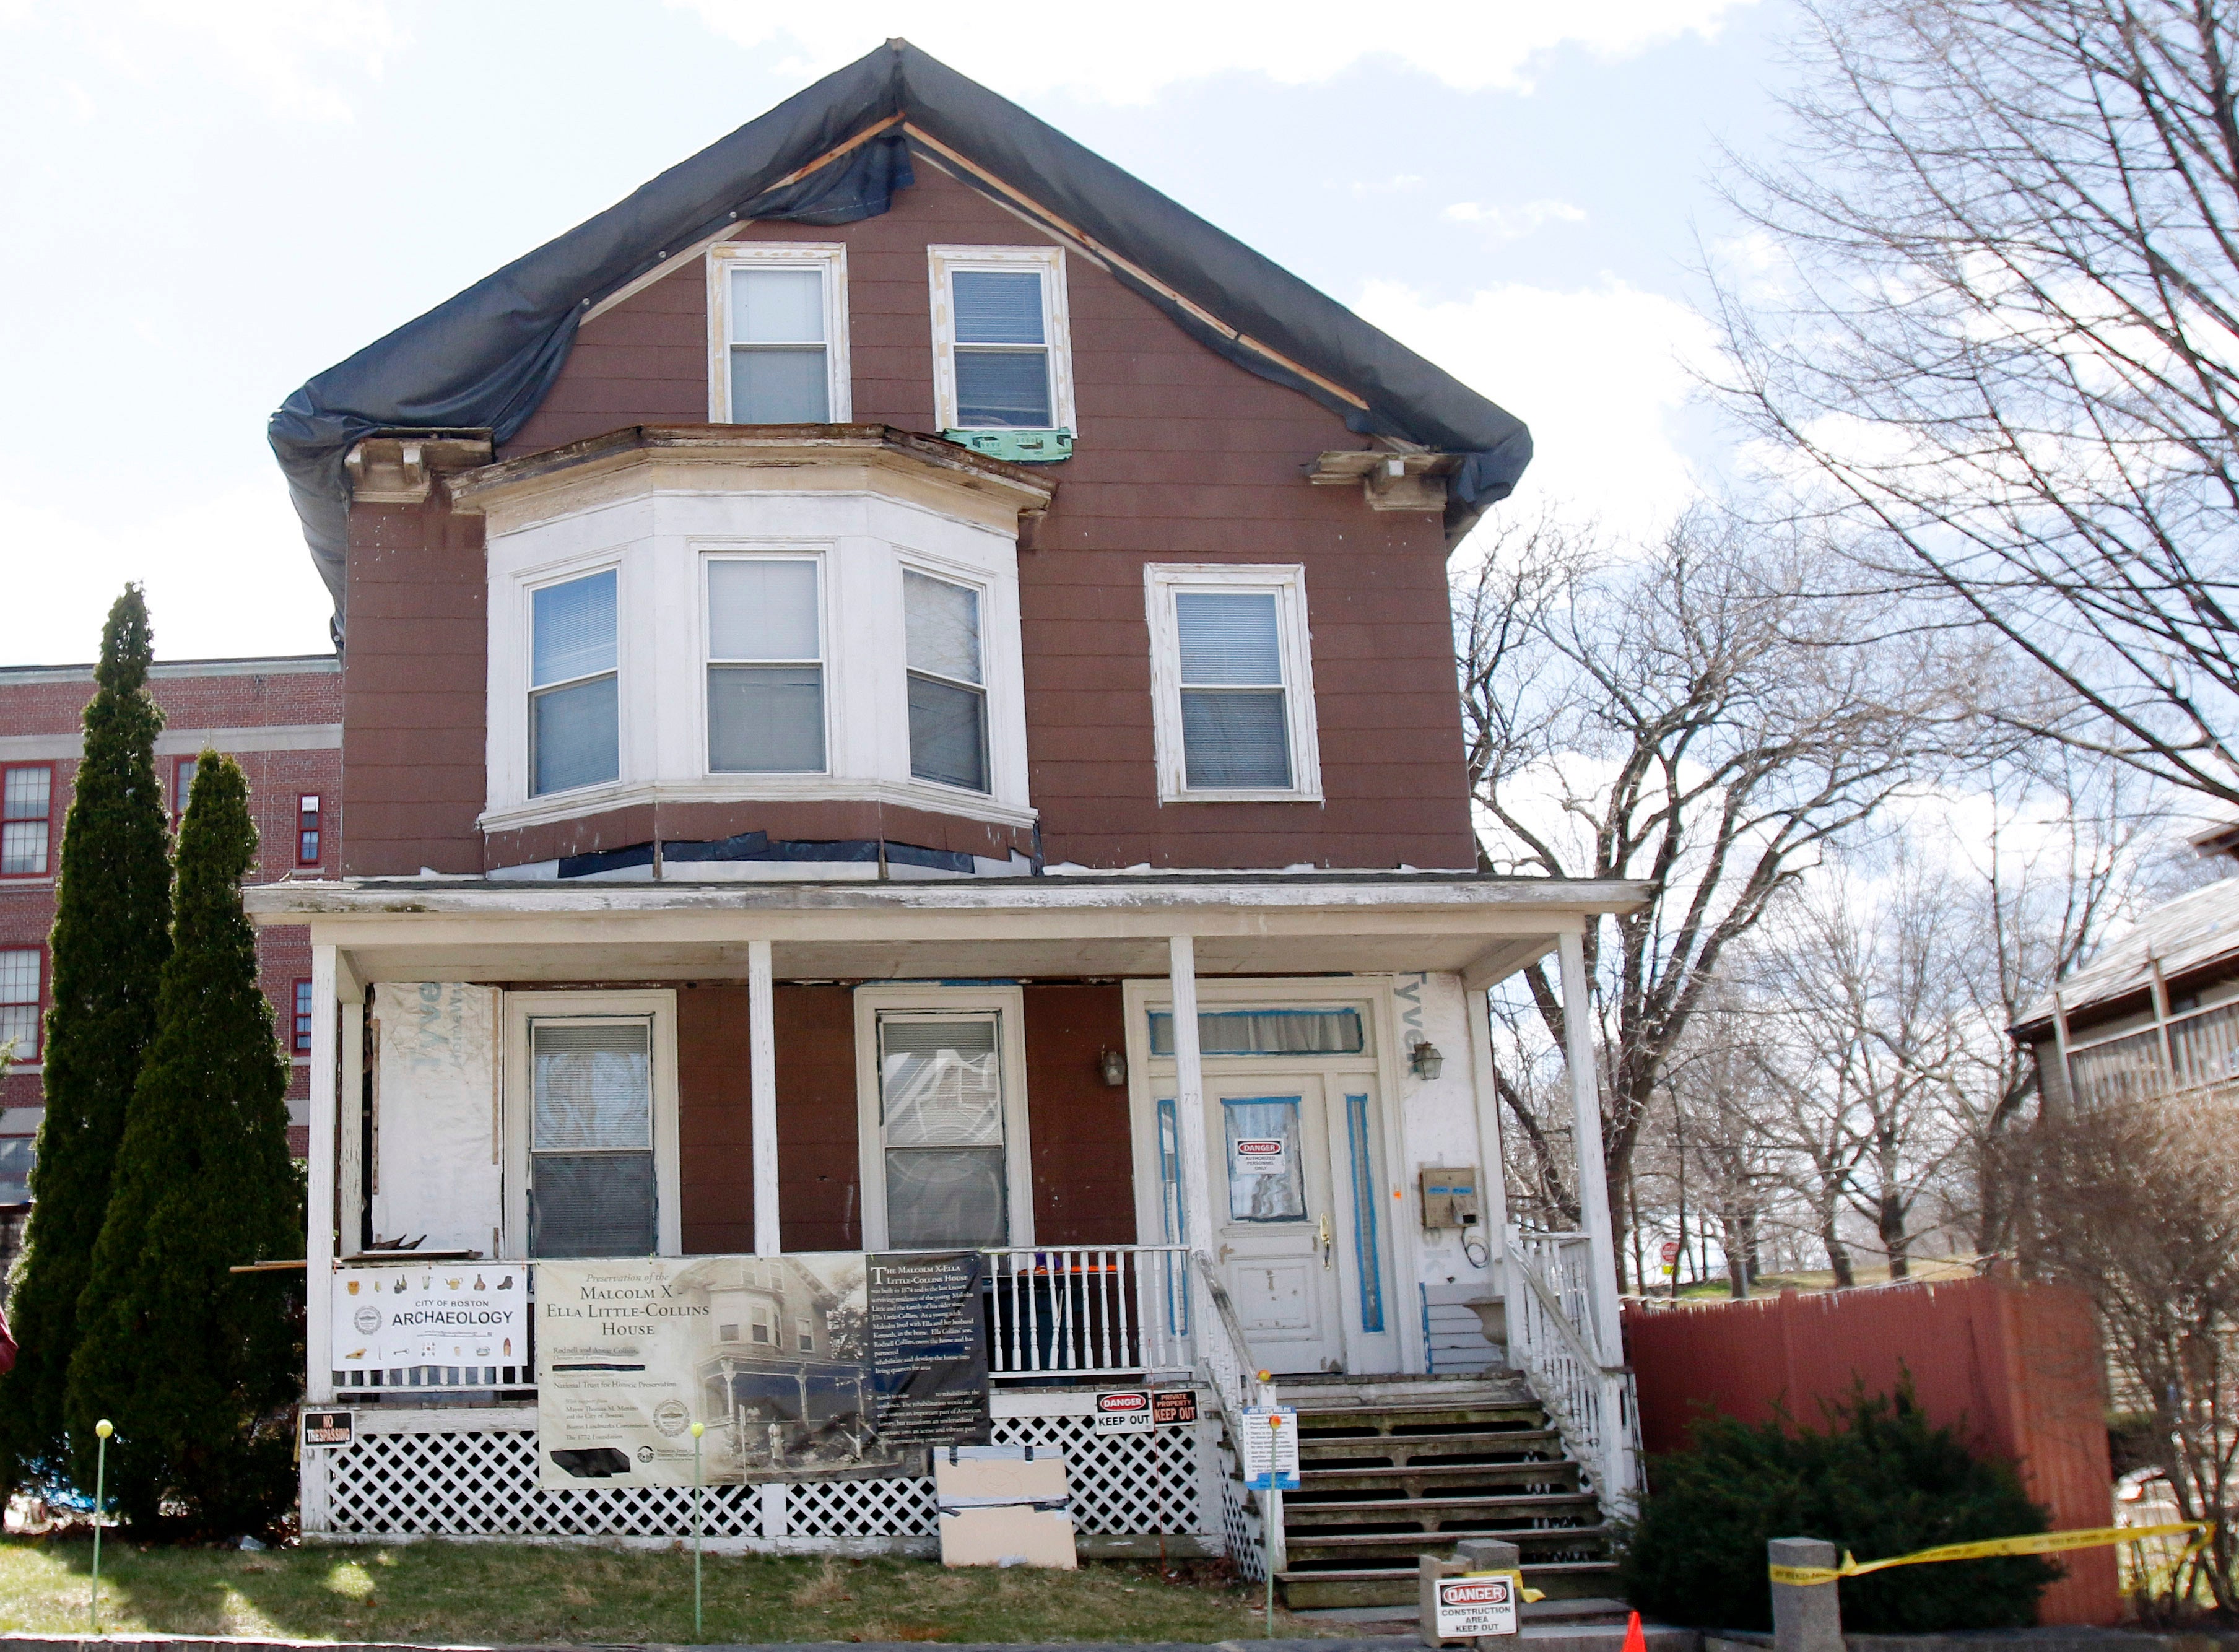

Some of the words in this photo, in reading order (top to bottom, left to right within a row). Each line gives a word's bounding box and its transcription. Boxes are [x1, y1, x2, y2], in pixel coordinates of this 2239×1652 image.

[586, 1274, 641, 1282] Preservation
[645, 1272, 653, 1283] of
[656, 1272, 669, 1282] the
[661, 1285, 674, 1298] X
[392, 1311, 513, 1326] ARCHAEOLOGY
[874, 1349, 898, 1358] partnered
[891, 1367, 911, 1375] quarters
[1104, 1399, 1142, 1407] DANGER
[1155, 1408, 1176, 1421] KEEP
[1180, 1407, 1195, 1420] OUT
[323, 1415, 334, 1428] NO
[1099, 1416, 1125, 1426] KEEP
[1130, 1415, 1149, 1424] OUT
[307, 1428, 350, 1442] TRESPASSING
[1448, 1587, 1503, 1601] DANGER
[1442, 1607, 1510, 1616] CONSTRUCTION
